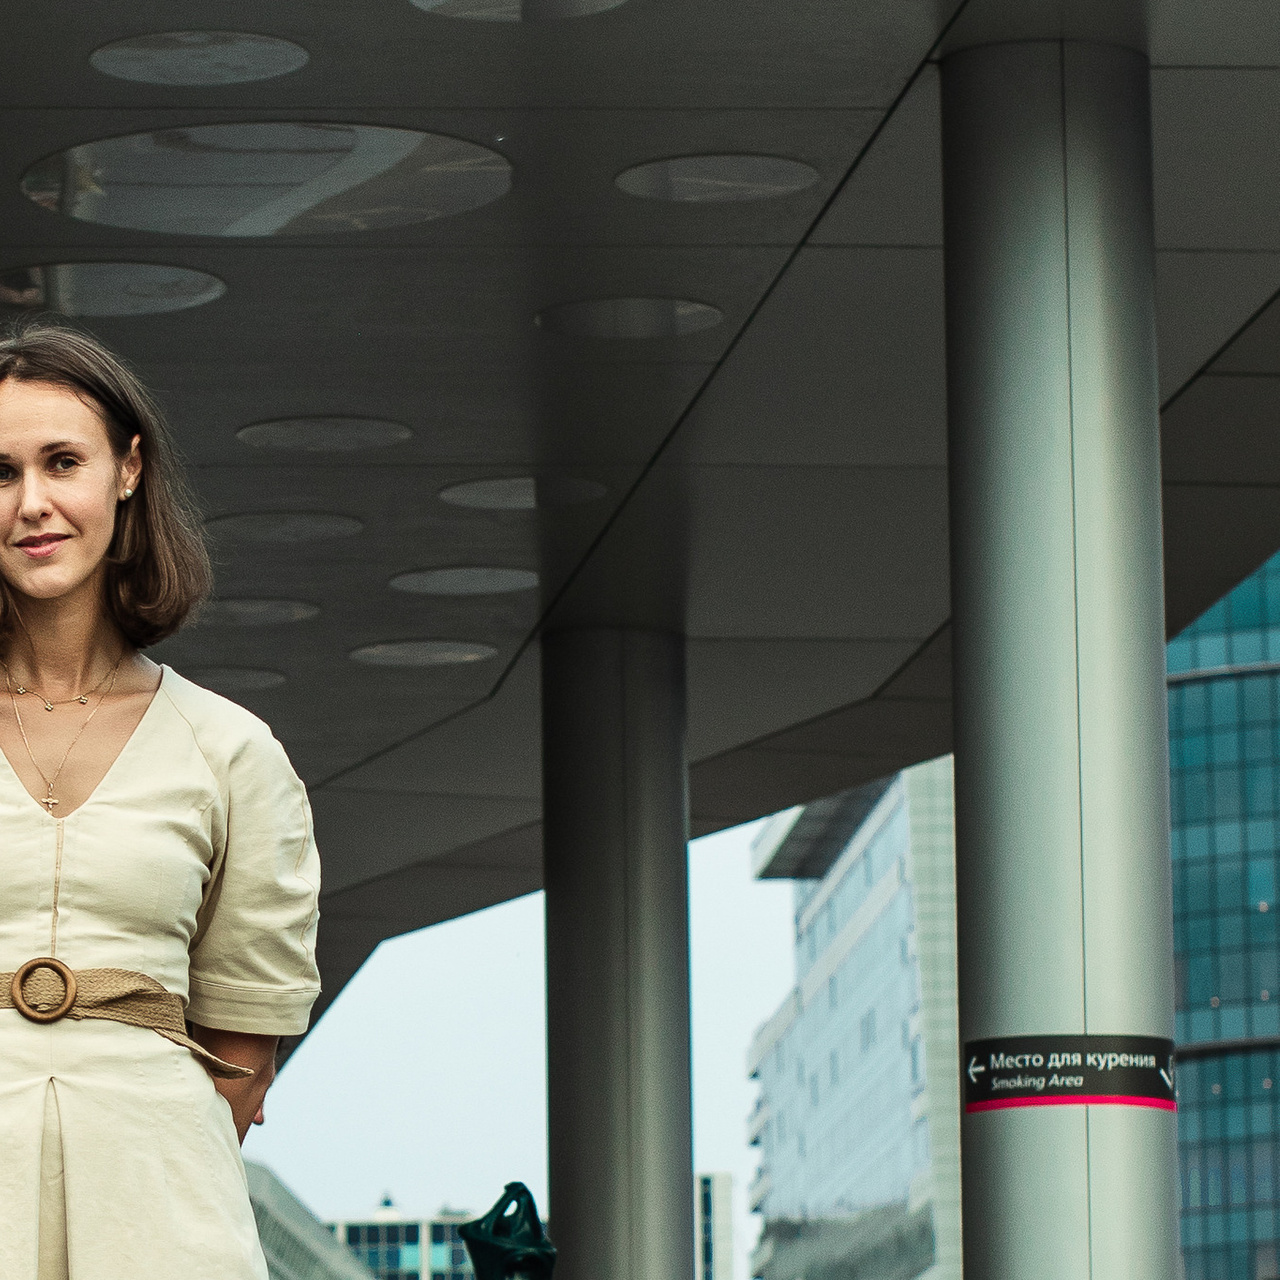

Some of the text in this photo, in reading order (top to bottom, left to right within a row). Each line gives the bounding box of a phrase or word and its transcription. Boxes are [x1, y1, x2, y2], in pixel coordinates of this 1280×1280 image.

[990, 1051, 1156, 1070] Место для курения
[991, 1073, 1083, 1091] Smoking Area
